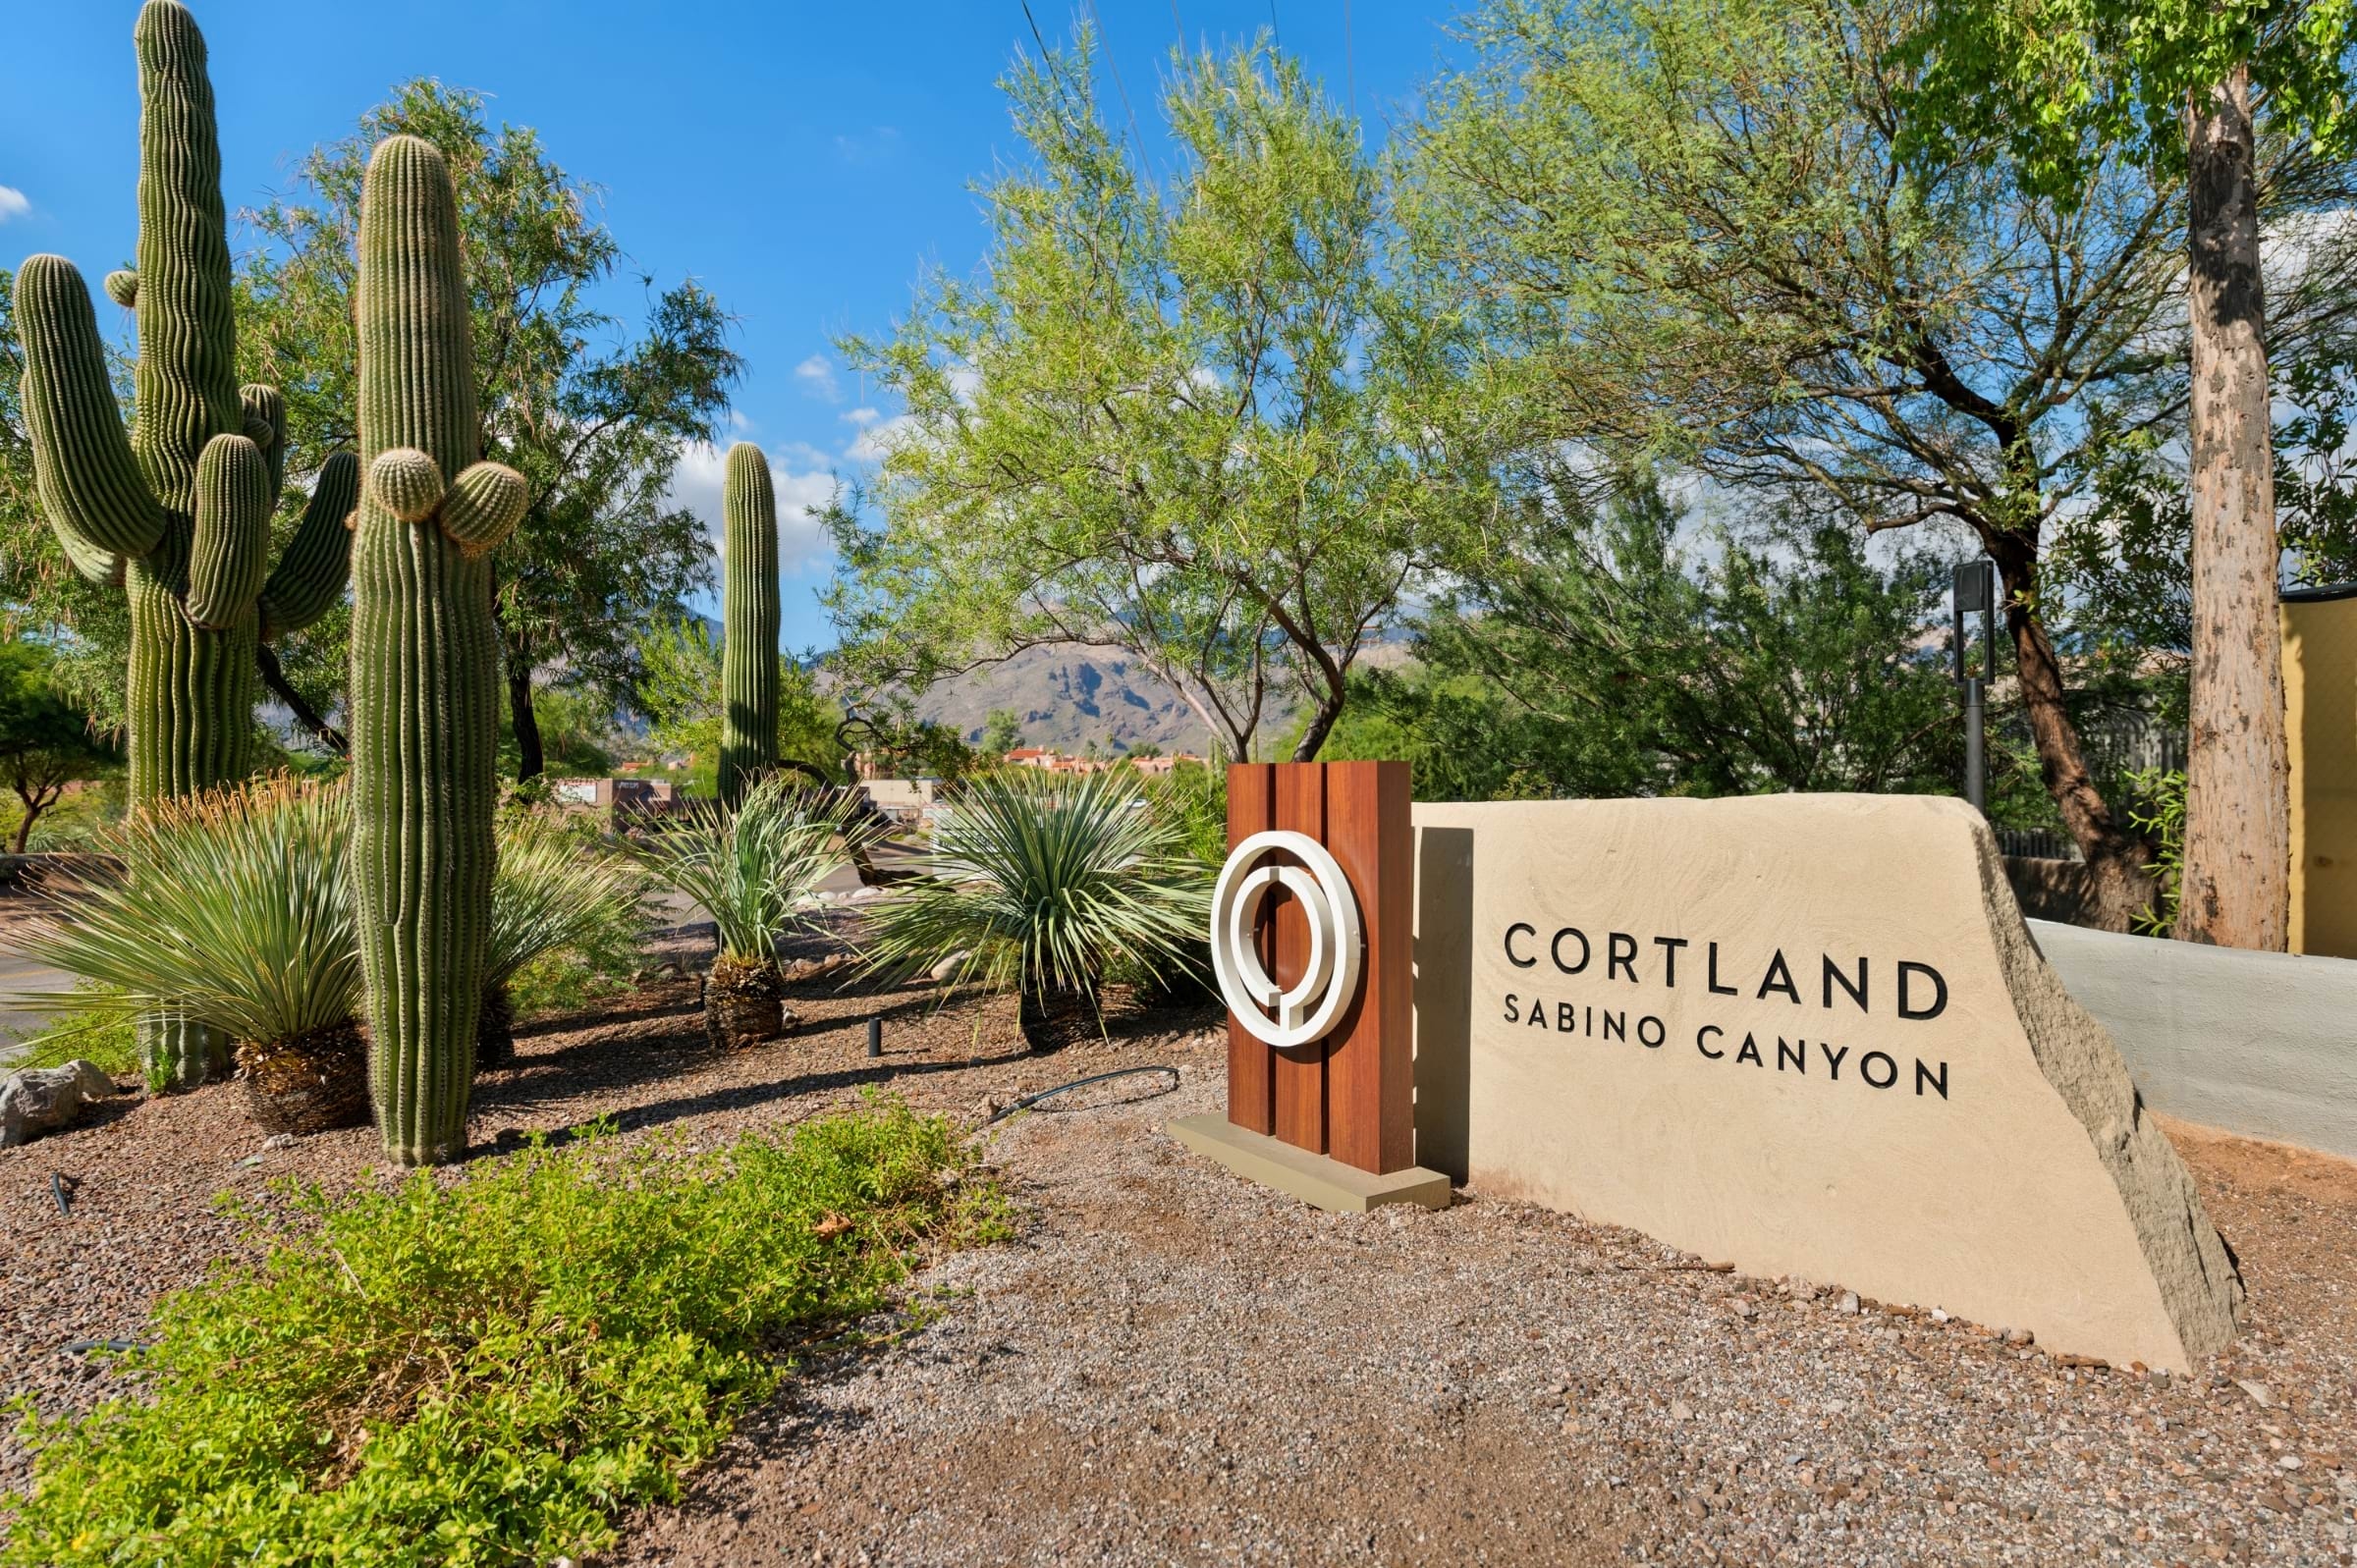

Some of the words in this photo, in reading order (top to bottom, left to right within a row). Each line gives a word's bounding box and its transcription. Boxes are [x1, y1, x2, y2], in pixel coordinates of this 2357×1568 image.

[1504, 922, 1948, 1021] CORTLAND
[1504, 994, 1667, 1049] SABINO
[1696, 1025, 1948, 1101] CANYON
